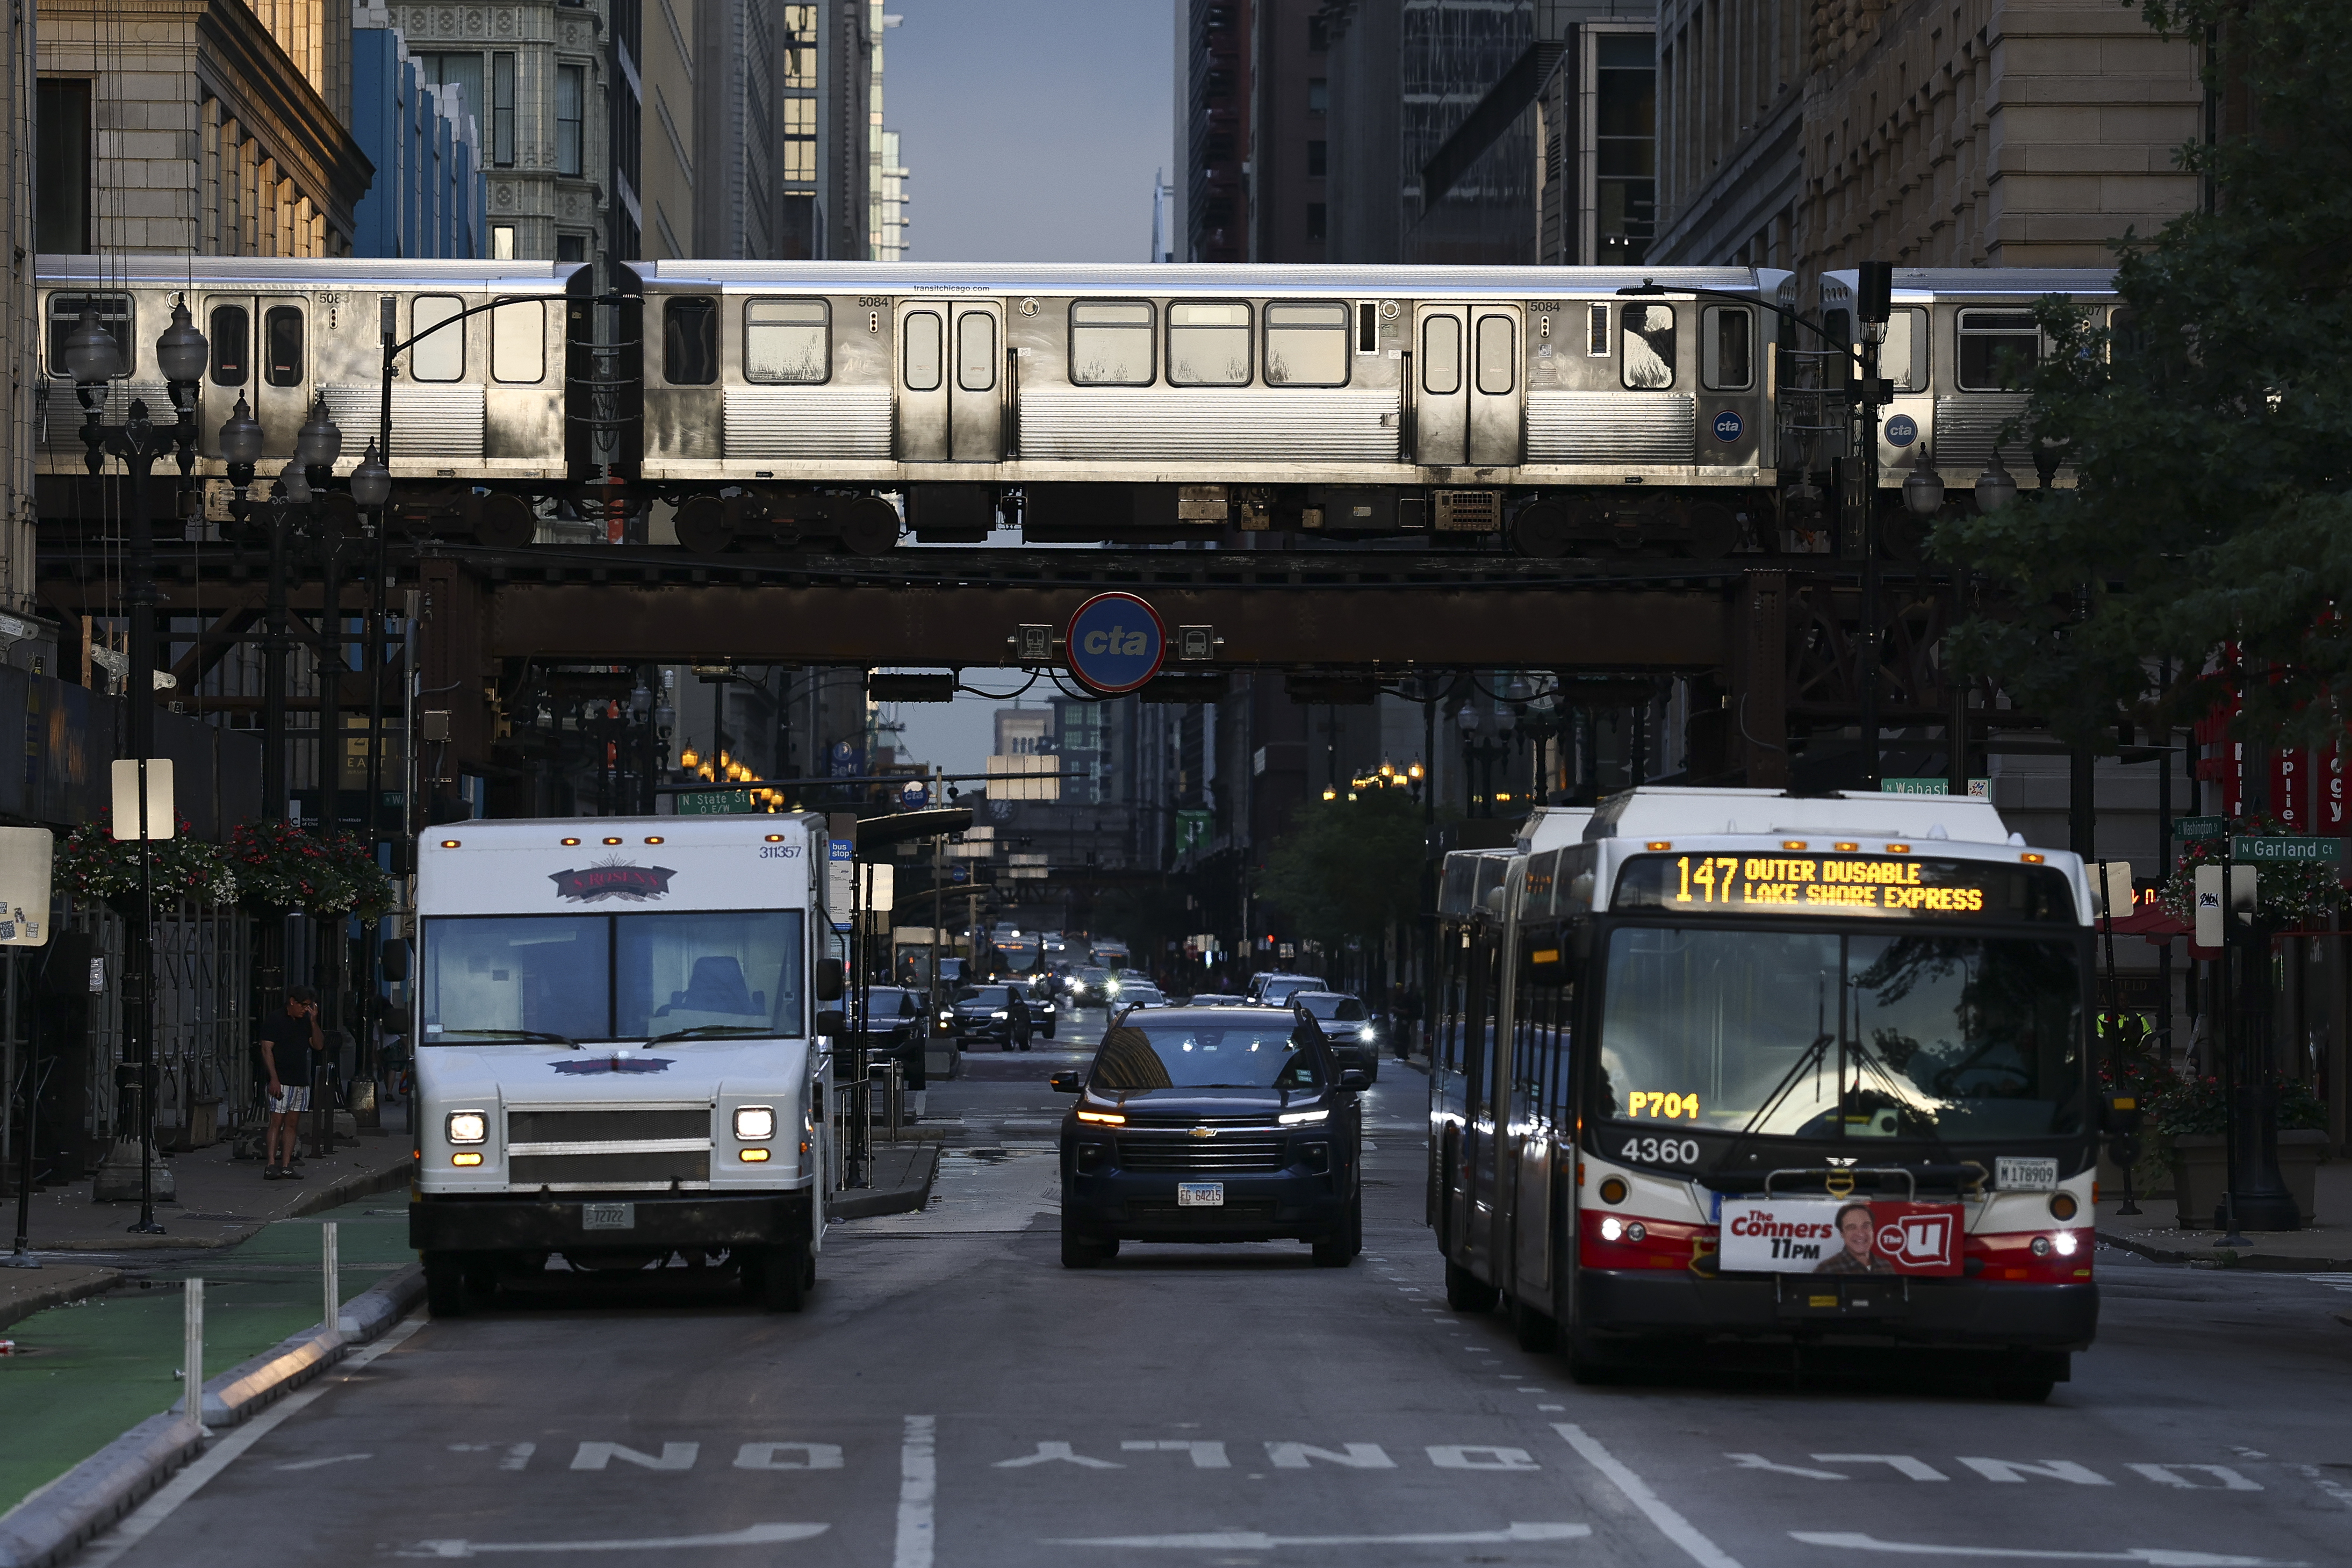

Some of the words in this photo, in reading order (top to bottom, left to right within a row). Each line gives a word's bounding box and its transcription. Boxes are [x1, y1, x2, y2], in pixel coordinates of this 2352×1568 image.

[914, 285, 990, 293] transitchicago.com
[858, 297, 889, 307] 5084
[1530, 301, 1561, 312] 5084
[2079, 305, 2102, 316] 107
[1717, 421, 1739, 431] cta
[1890, 426, 1911, 436] cta
[1084, 625, 1148, 656] cta
[348, 757, 385, 767] EAT
[1895, 782, 1948, 796] Wabash
[682, 795, 689, 805] N
[697, 793, 727, 804] State
[735, 792, 746, 803] St
[712, 804, 730, 813] E/W
[2178, 825, 2181, 835] E
[2183, 819, 2213, 838] Washington
[2213, 823, 2218, 832] St
[759, 846, 801, 859] 311357
[832, 850, 850, 858] stop
[2242, 843, 2249, 853] N
[2254, 840, 2316, 857] Garland
[2322, 844, 2332, 854] Ct
[1744, 859, 1816, 882] OUTER
[1823, 861, 1922, 885] DUSABLE
[1676, 857, 1738, 903] 147
[1744, 882, 1800, 905] LAKE
[1806, 884, 1878, 908] SHORE
[1884, 887, 1983, 911] EXPRESS
[2119, 980, 2148, 990] IELD
[1629, 1091, 1700, 1119] P704
[1621, 1137, 1700, 1164] 4360
[1180, 1190, 1191, 1201] FG
[1196, 1190, 1221, 1201] 64215
[1749, 1210, 1774, 1222] The
[1731, 1217, 1832, 1239] Conners
[1883, 1234, 1902, 1245] The
[1907, 1224, 1941, 1256] U
[1770, 1239, 1820, 1260] 11PM
[990, 1440, 1542, 1470] ONLY
[1723, 1452, 2264, 1492] ONLY
